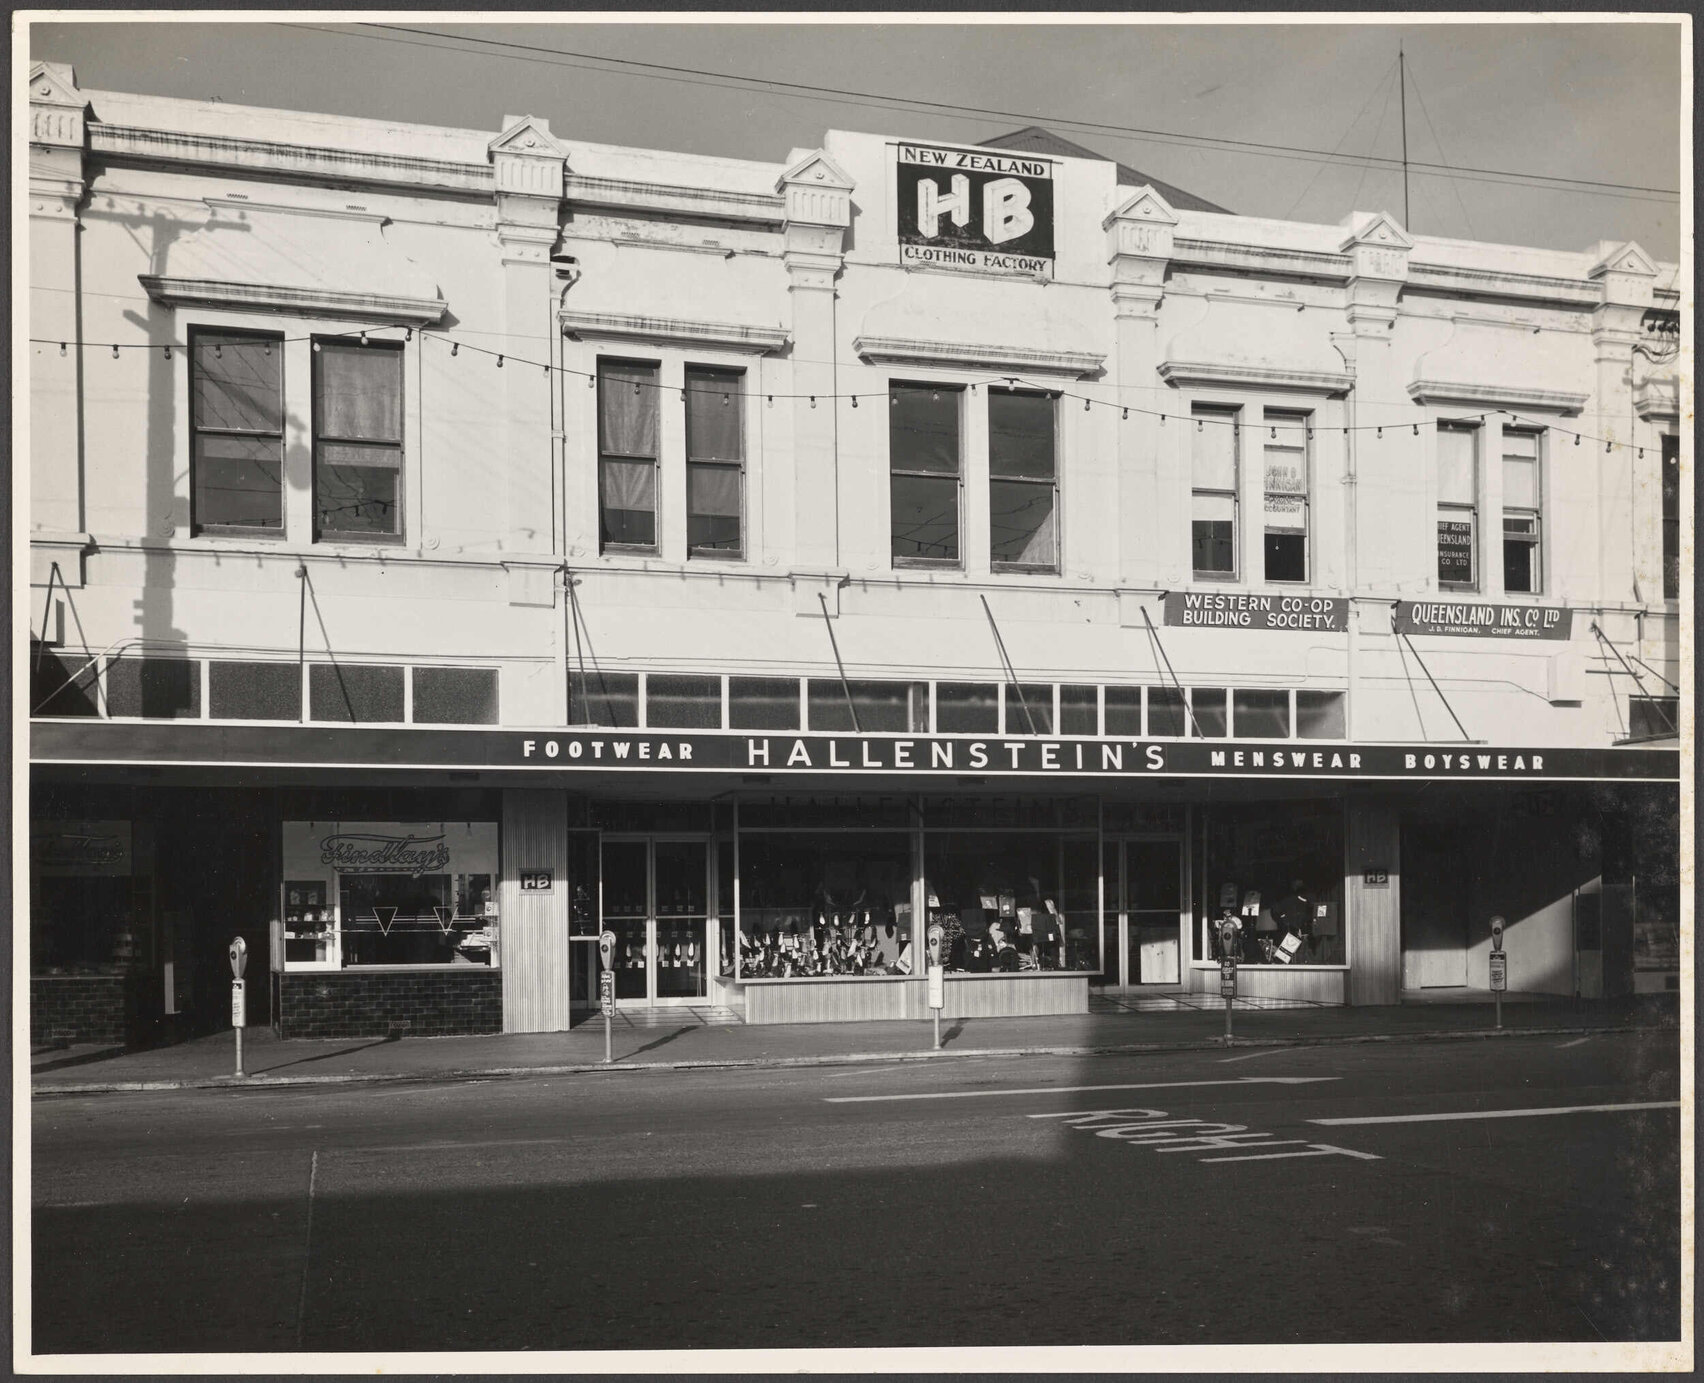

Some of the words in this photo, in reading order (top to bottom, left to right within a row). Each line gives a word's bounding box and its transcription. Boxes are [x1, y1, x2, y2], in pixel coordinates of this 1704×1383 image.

[905, 147, 948, 165] NEW
[956, 153, 1045, 176] ZEALAND
[917, 173, 1035, 245] HB
[904, 246, 976, 265] CLOTHING
[984, 255, 1047, 271] FACTORY
[1264, 502, 1301, 513] CCOUNTANT
[1450, 523, 1470, 531] AGENT
[1439, 551, 1469, 559] NSURANCE
[1184, 594, 1271, 612] WESTERN
[1281, 598, 1334, 613] CO-OP
[1411, 603, 1494, 626] QUEENSLAND
[1500, 607, 1522, 627] INS.
[1183, 610, 1251, 626] BUILDING
[1266, 613, 1336, 629] SOCIETY.
[523, 740, 693, 760] FOOTWEAR
[748, 738, 1164, 770] HALLENSTEIN'S
[1211, 751, 1361, 768] MENSWEAR
[1405, 754, 1543, 770] BOYSWEAR
[320, 834, 450, 876] Findlay's
[523, 874, 549, 889] HB
[1025, 1108, 1386, 1163] RIGHT
